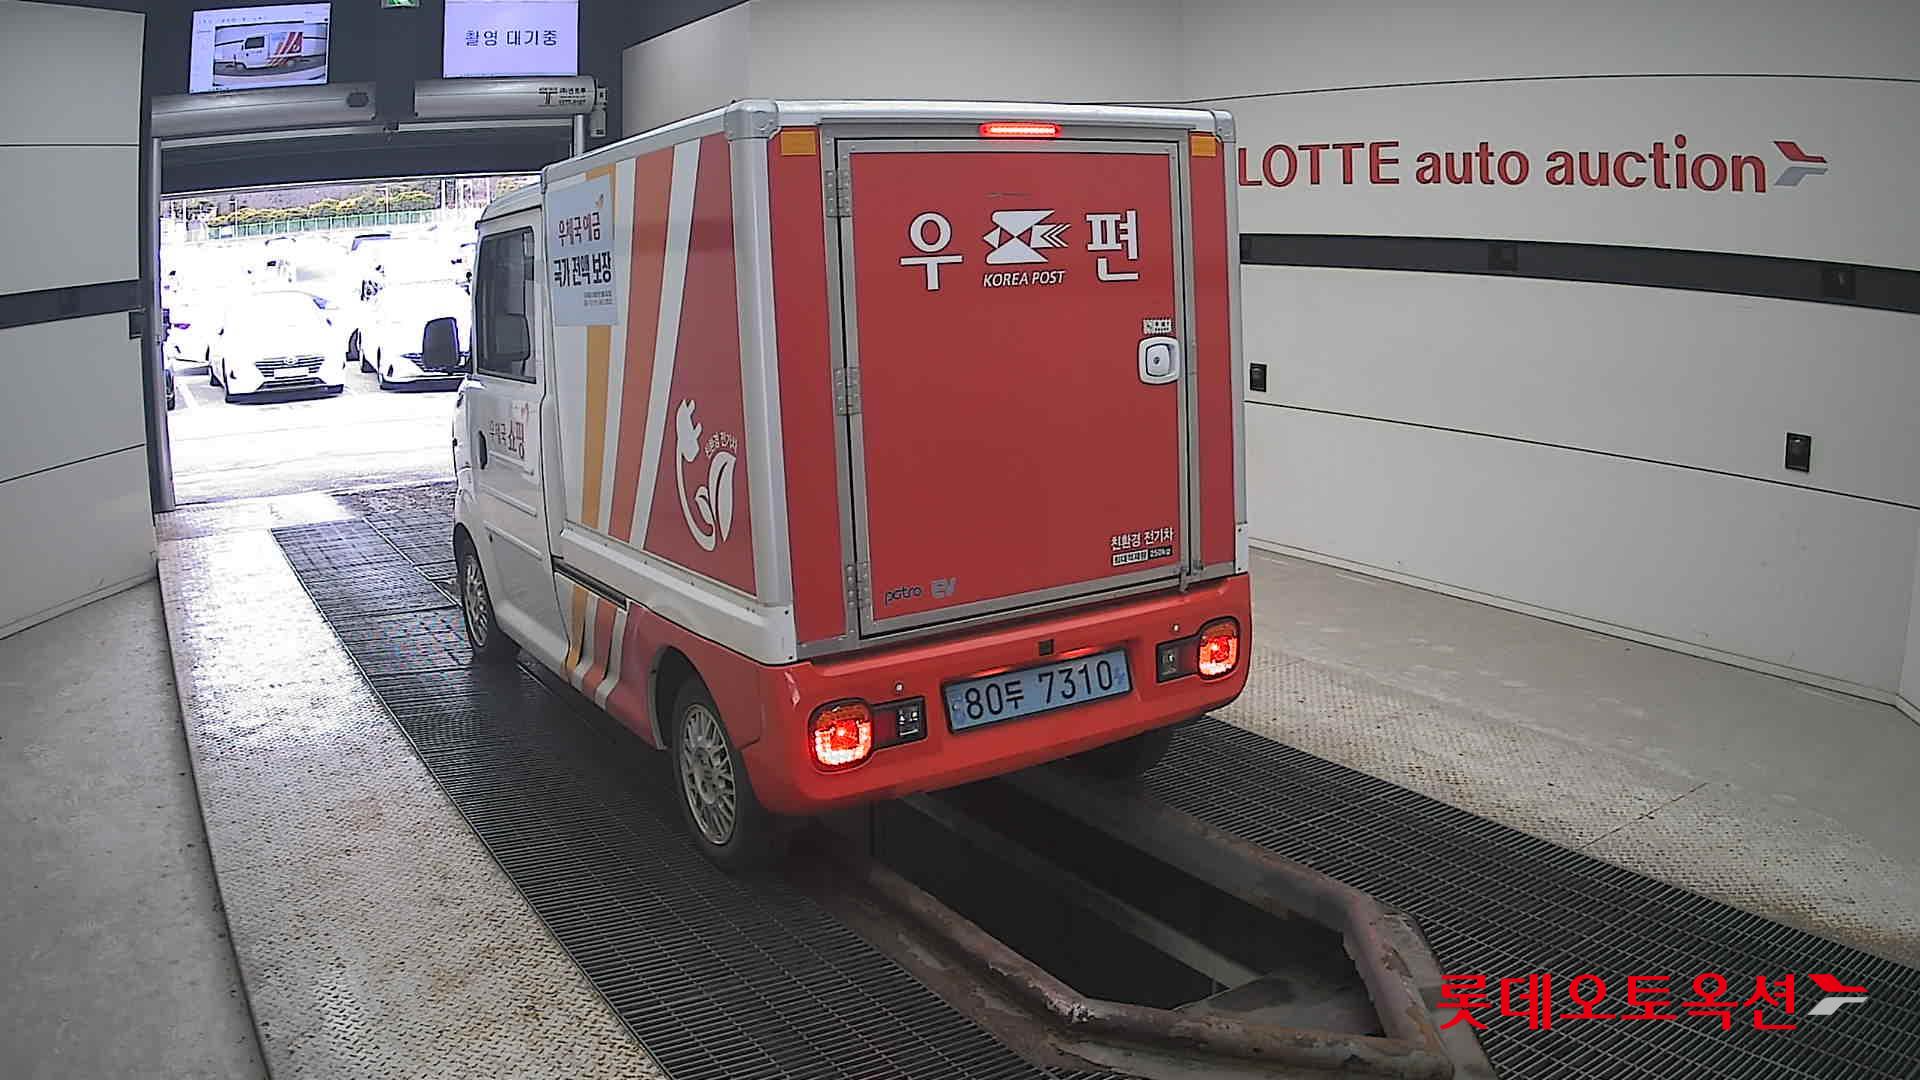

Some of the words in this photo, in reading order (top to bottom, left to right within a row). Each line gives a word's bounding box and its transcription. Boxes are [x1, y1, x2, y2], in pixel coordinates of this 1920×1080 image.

[465, 30, 498, 46] 촬영
[506, 30, 557, 46] 대기중
[1238, 141, 1400, 187] LOTTE
[1415, 142, 1530, 186] auto
[1545, 134, 1767, 193] auction
[553, 257, 571, 288] 국가
[571, 254, 591, 286] 전액
[592, 250, 612, 284] 보장
[899, 211, 963, 291] 우
[1086, 209, 1139, 282] 편
[983, 272, 1030, 288] KOREA
[1032, 270, 1066, 286] POST
[508, 419, 525, 460] 쇼핑
[1111, 532, 1142, 551] 친환경
[1143, 527, 1174, 545] 전기차
[964, 680, 1025, 720] 80두
[1038, 660, 1113, 704] 7310
